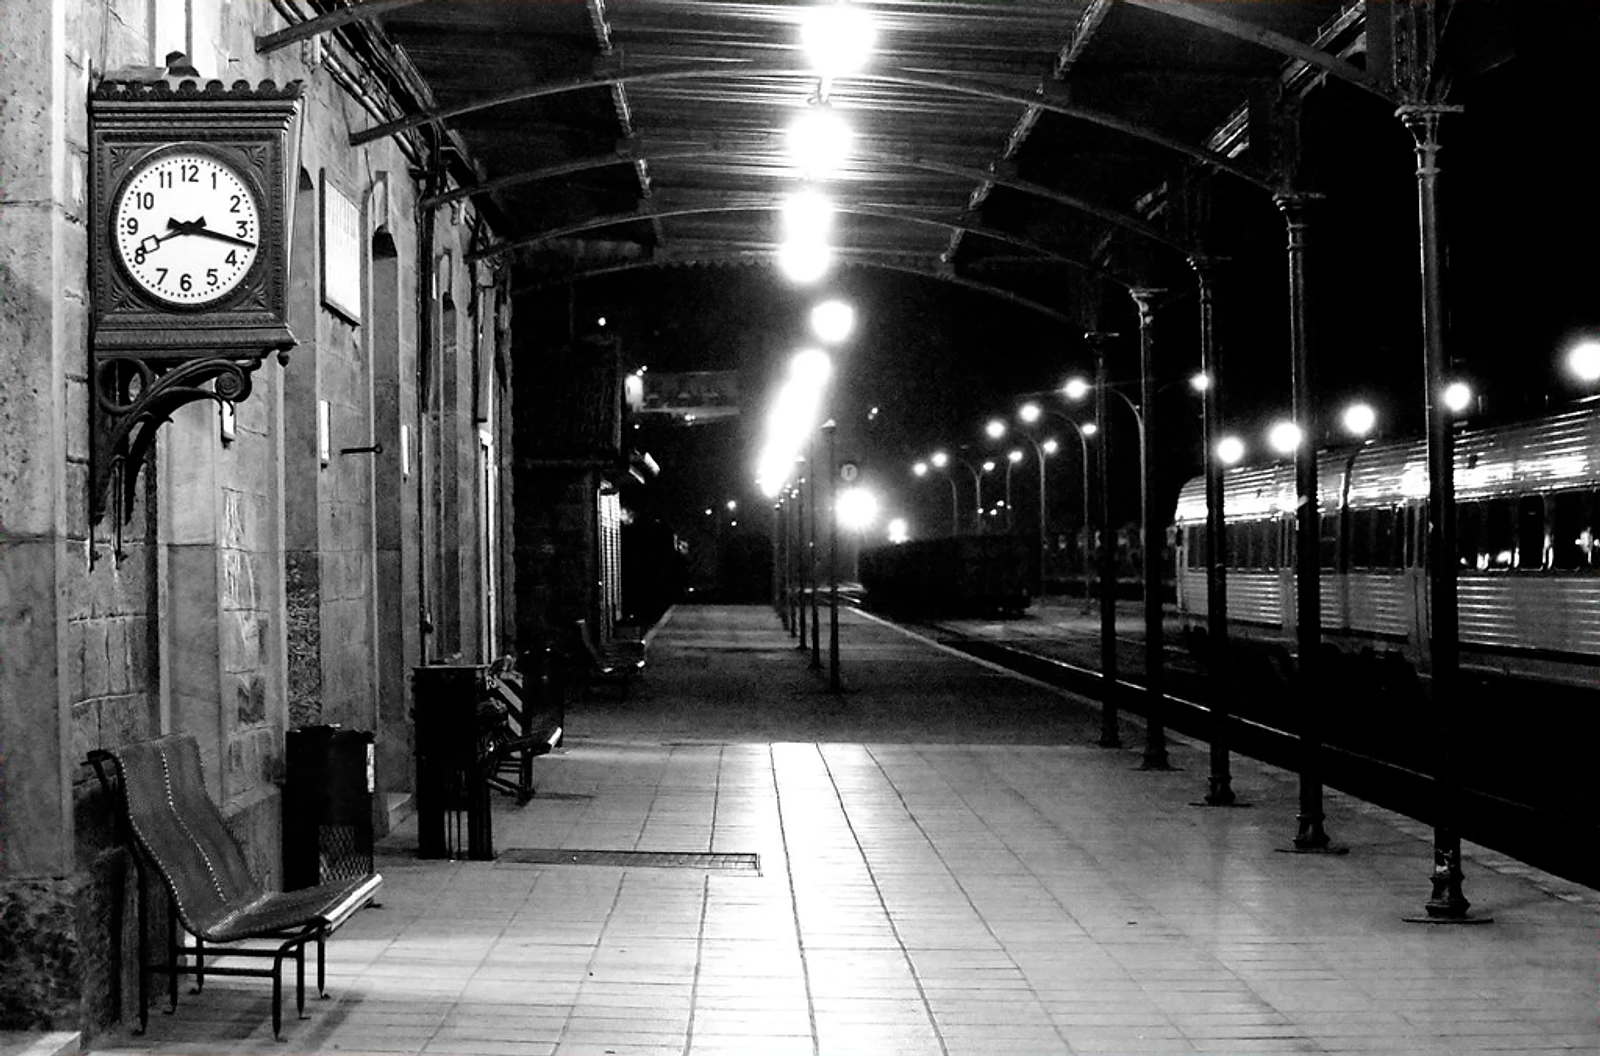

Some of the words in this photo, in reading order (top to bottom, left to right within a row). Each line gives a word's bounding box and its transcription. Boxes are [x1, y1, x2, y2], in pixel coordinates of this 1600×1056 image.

[159, 171, 172, 188] 11
[181, 165, 199, 182] 12
[211, 171, 217, 190] 1
[136, 192, 154, 210] 10
[229, 195, 241, 213] 2
[126, 217, 138, 235] 9
[236, 221, 248, 238] 3
[134, 247, 146, 265] 8
[224, 250, 237, 266] 4
[155, 268, 168, 285] 7
[179, 274, 192, 292] 6
[206, 269, 218, 286] 5
